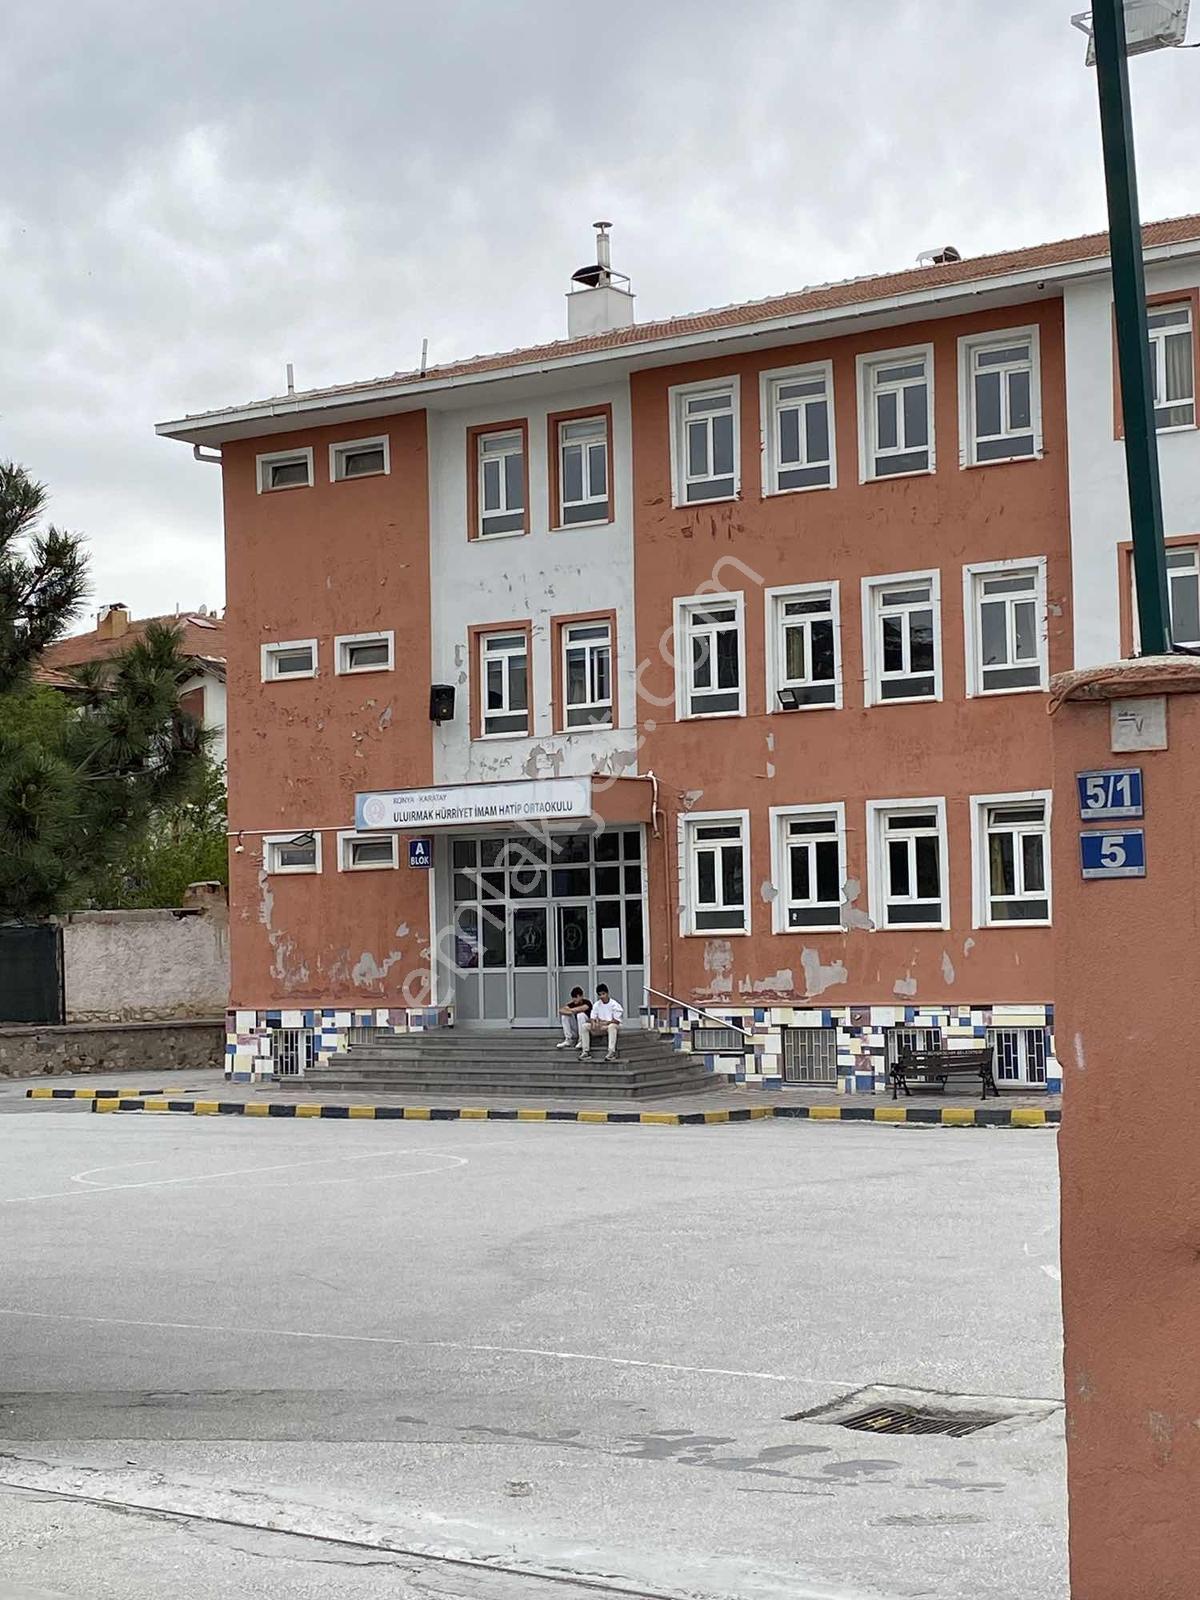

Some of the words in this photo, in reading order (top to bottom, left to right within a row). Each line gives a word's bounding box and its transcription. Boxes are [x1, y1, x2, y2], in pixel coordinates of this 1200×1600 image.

[1086, 775, 1131, 808] 5/1
[394, 809, 434, 822] ULUIRMAK
[435, 806, 473, 820] HÜRRİYET
[474, 804, 498, 817] İMAM
[499, 802, 521, 815] HATİP
[523, 800, 573, 813] ORTAOKULU
[415, 842, 425, 855] A
[1100, 836, 1126, 868] 5
[410, 856, 430, 865] BLOK
